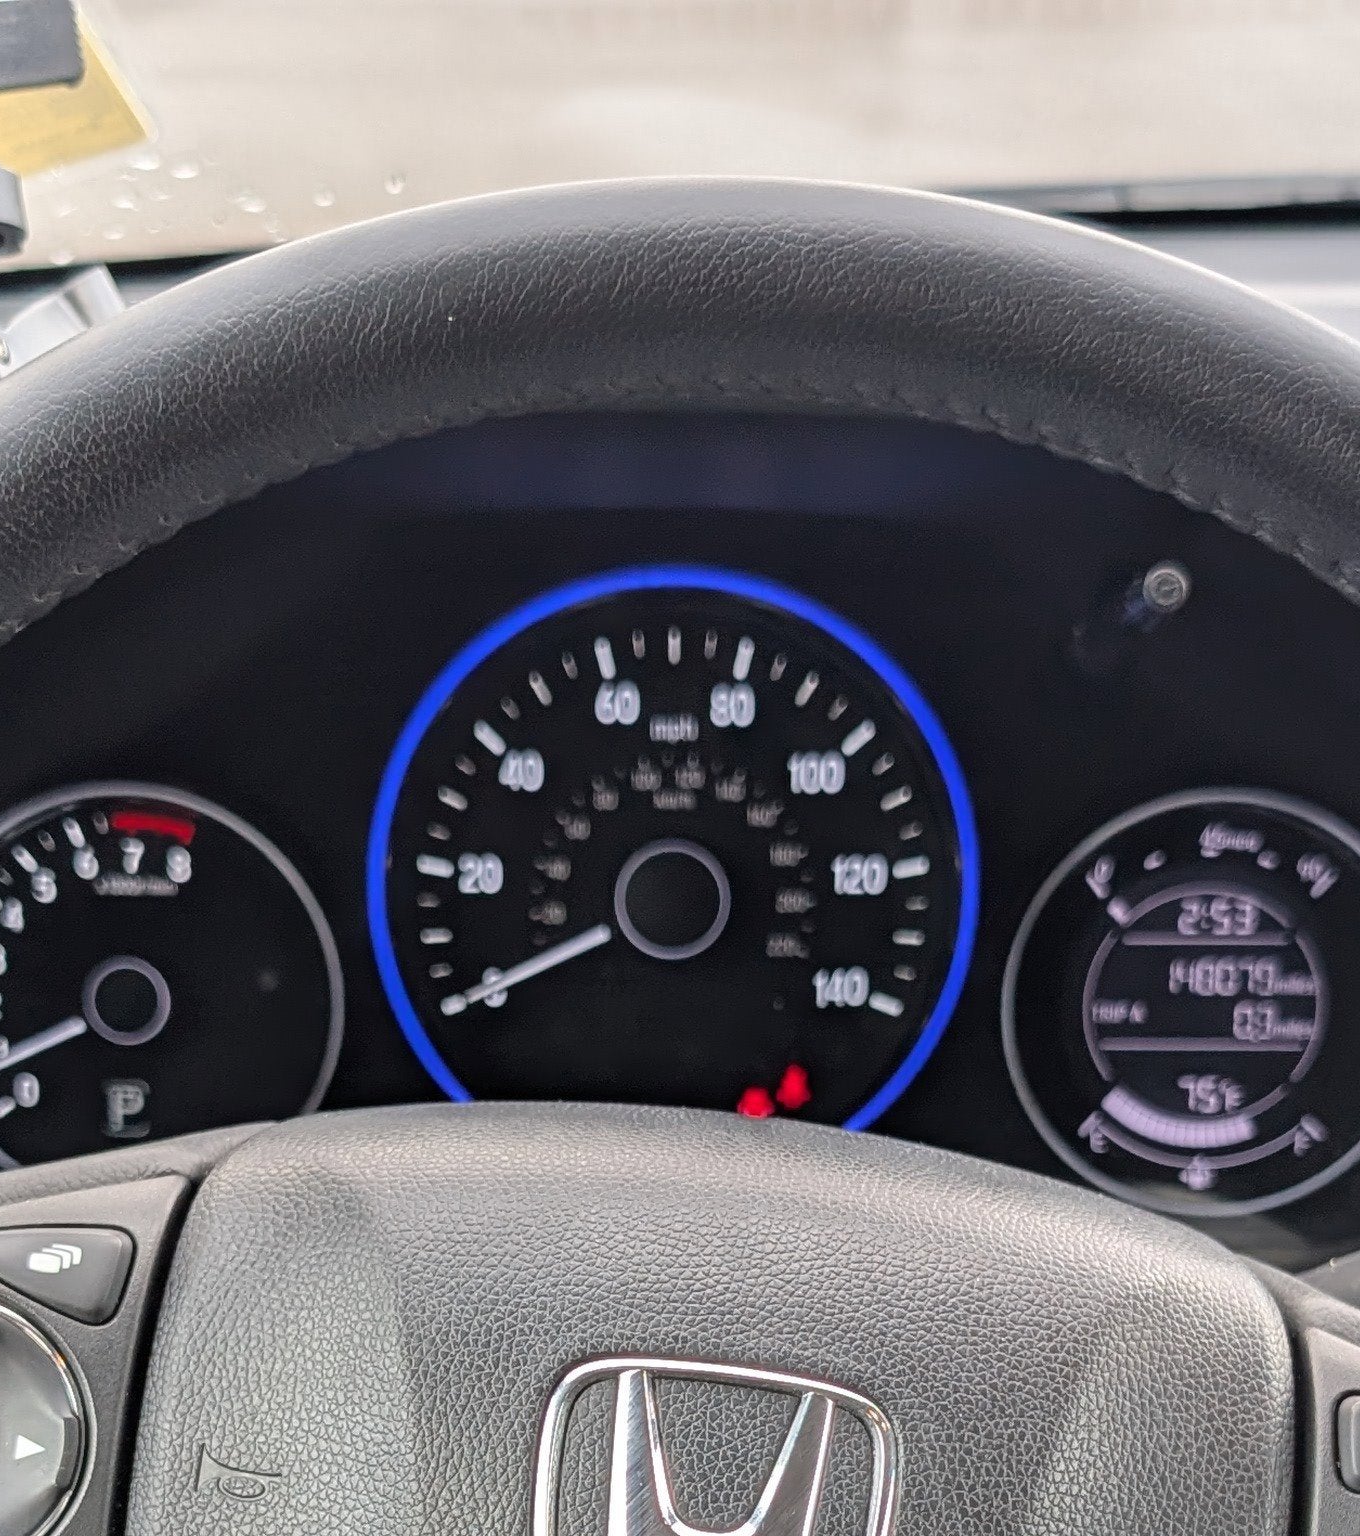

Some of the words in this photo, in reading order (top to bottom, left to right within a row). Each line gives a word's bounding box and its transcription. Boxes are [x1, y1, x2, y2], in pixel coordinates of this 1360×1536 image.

[594, 680, 641, 725] 60
[709, 683, 756, 728] 80
[498, 749, 545, 792] 40
[787, 750, 846, 794] 100
[457, 853, 504, 894] 20
[831, 852, 889, 896] 120
[813, 966, 871, 1009] 140
[106, 1083, 146, 1133] P
